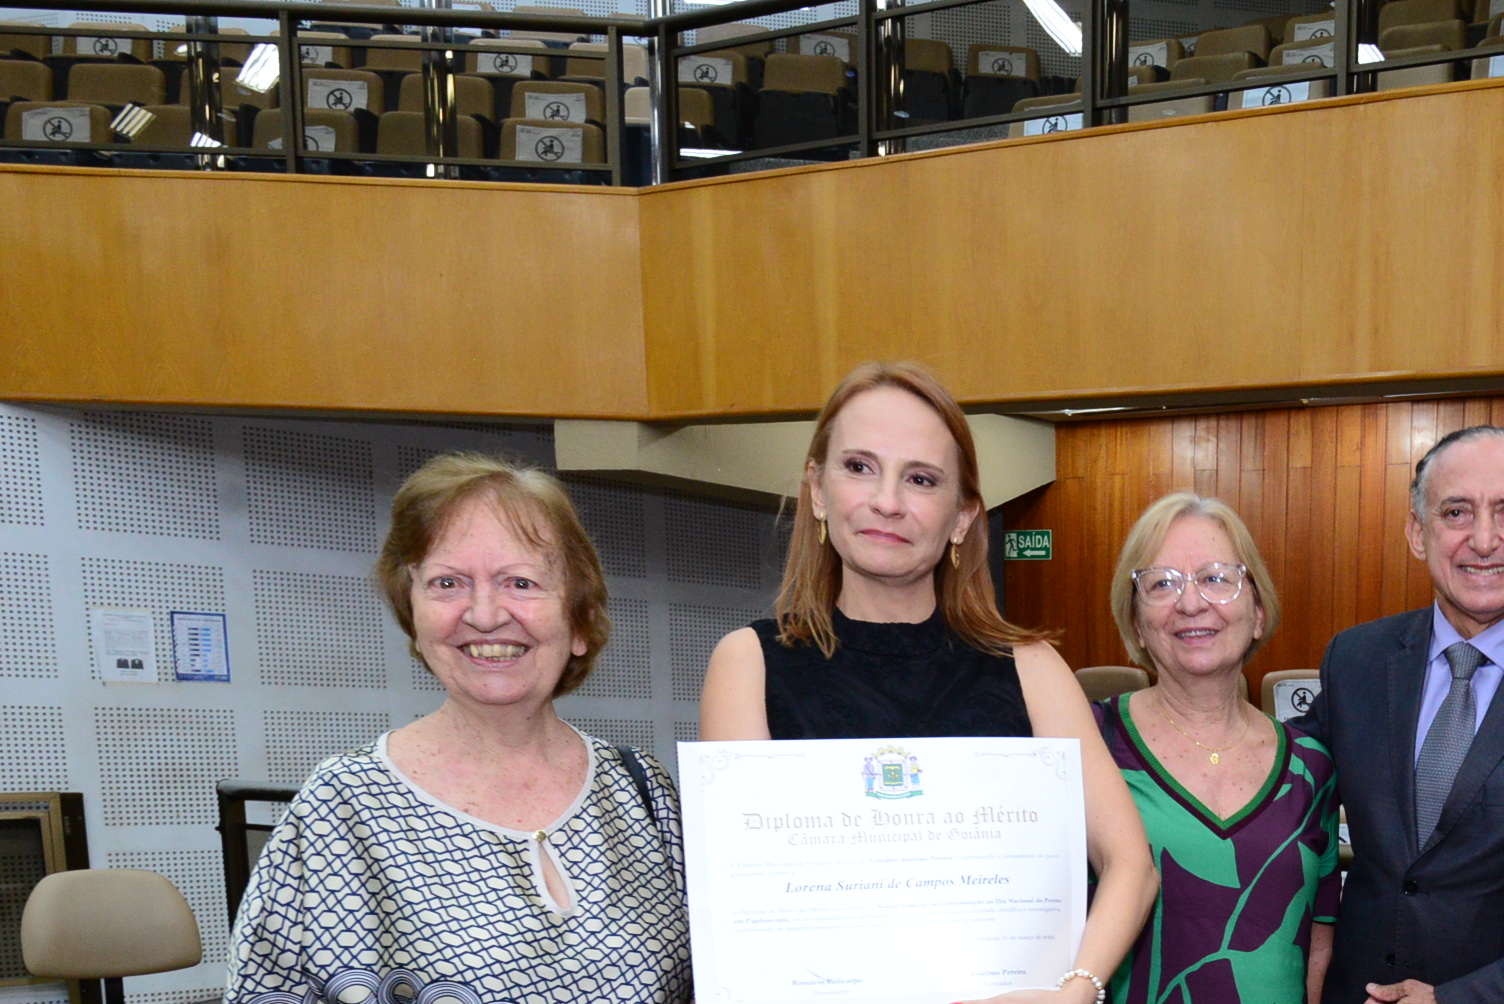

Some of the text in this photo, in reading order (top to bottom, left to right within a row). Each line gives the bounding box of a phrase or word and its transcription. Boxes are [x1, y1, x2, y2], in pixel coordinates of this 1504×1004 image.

[1018, 532, 1050, 548] SAÍDA
[742, 805, 1039, 832] Diploma de Honra ao Mérito
[787, 827, 1002, 846] Câmara Municipal de Goiânia
[786, 873, 1011, 894] Lorena Suriani de Campos Meireles
